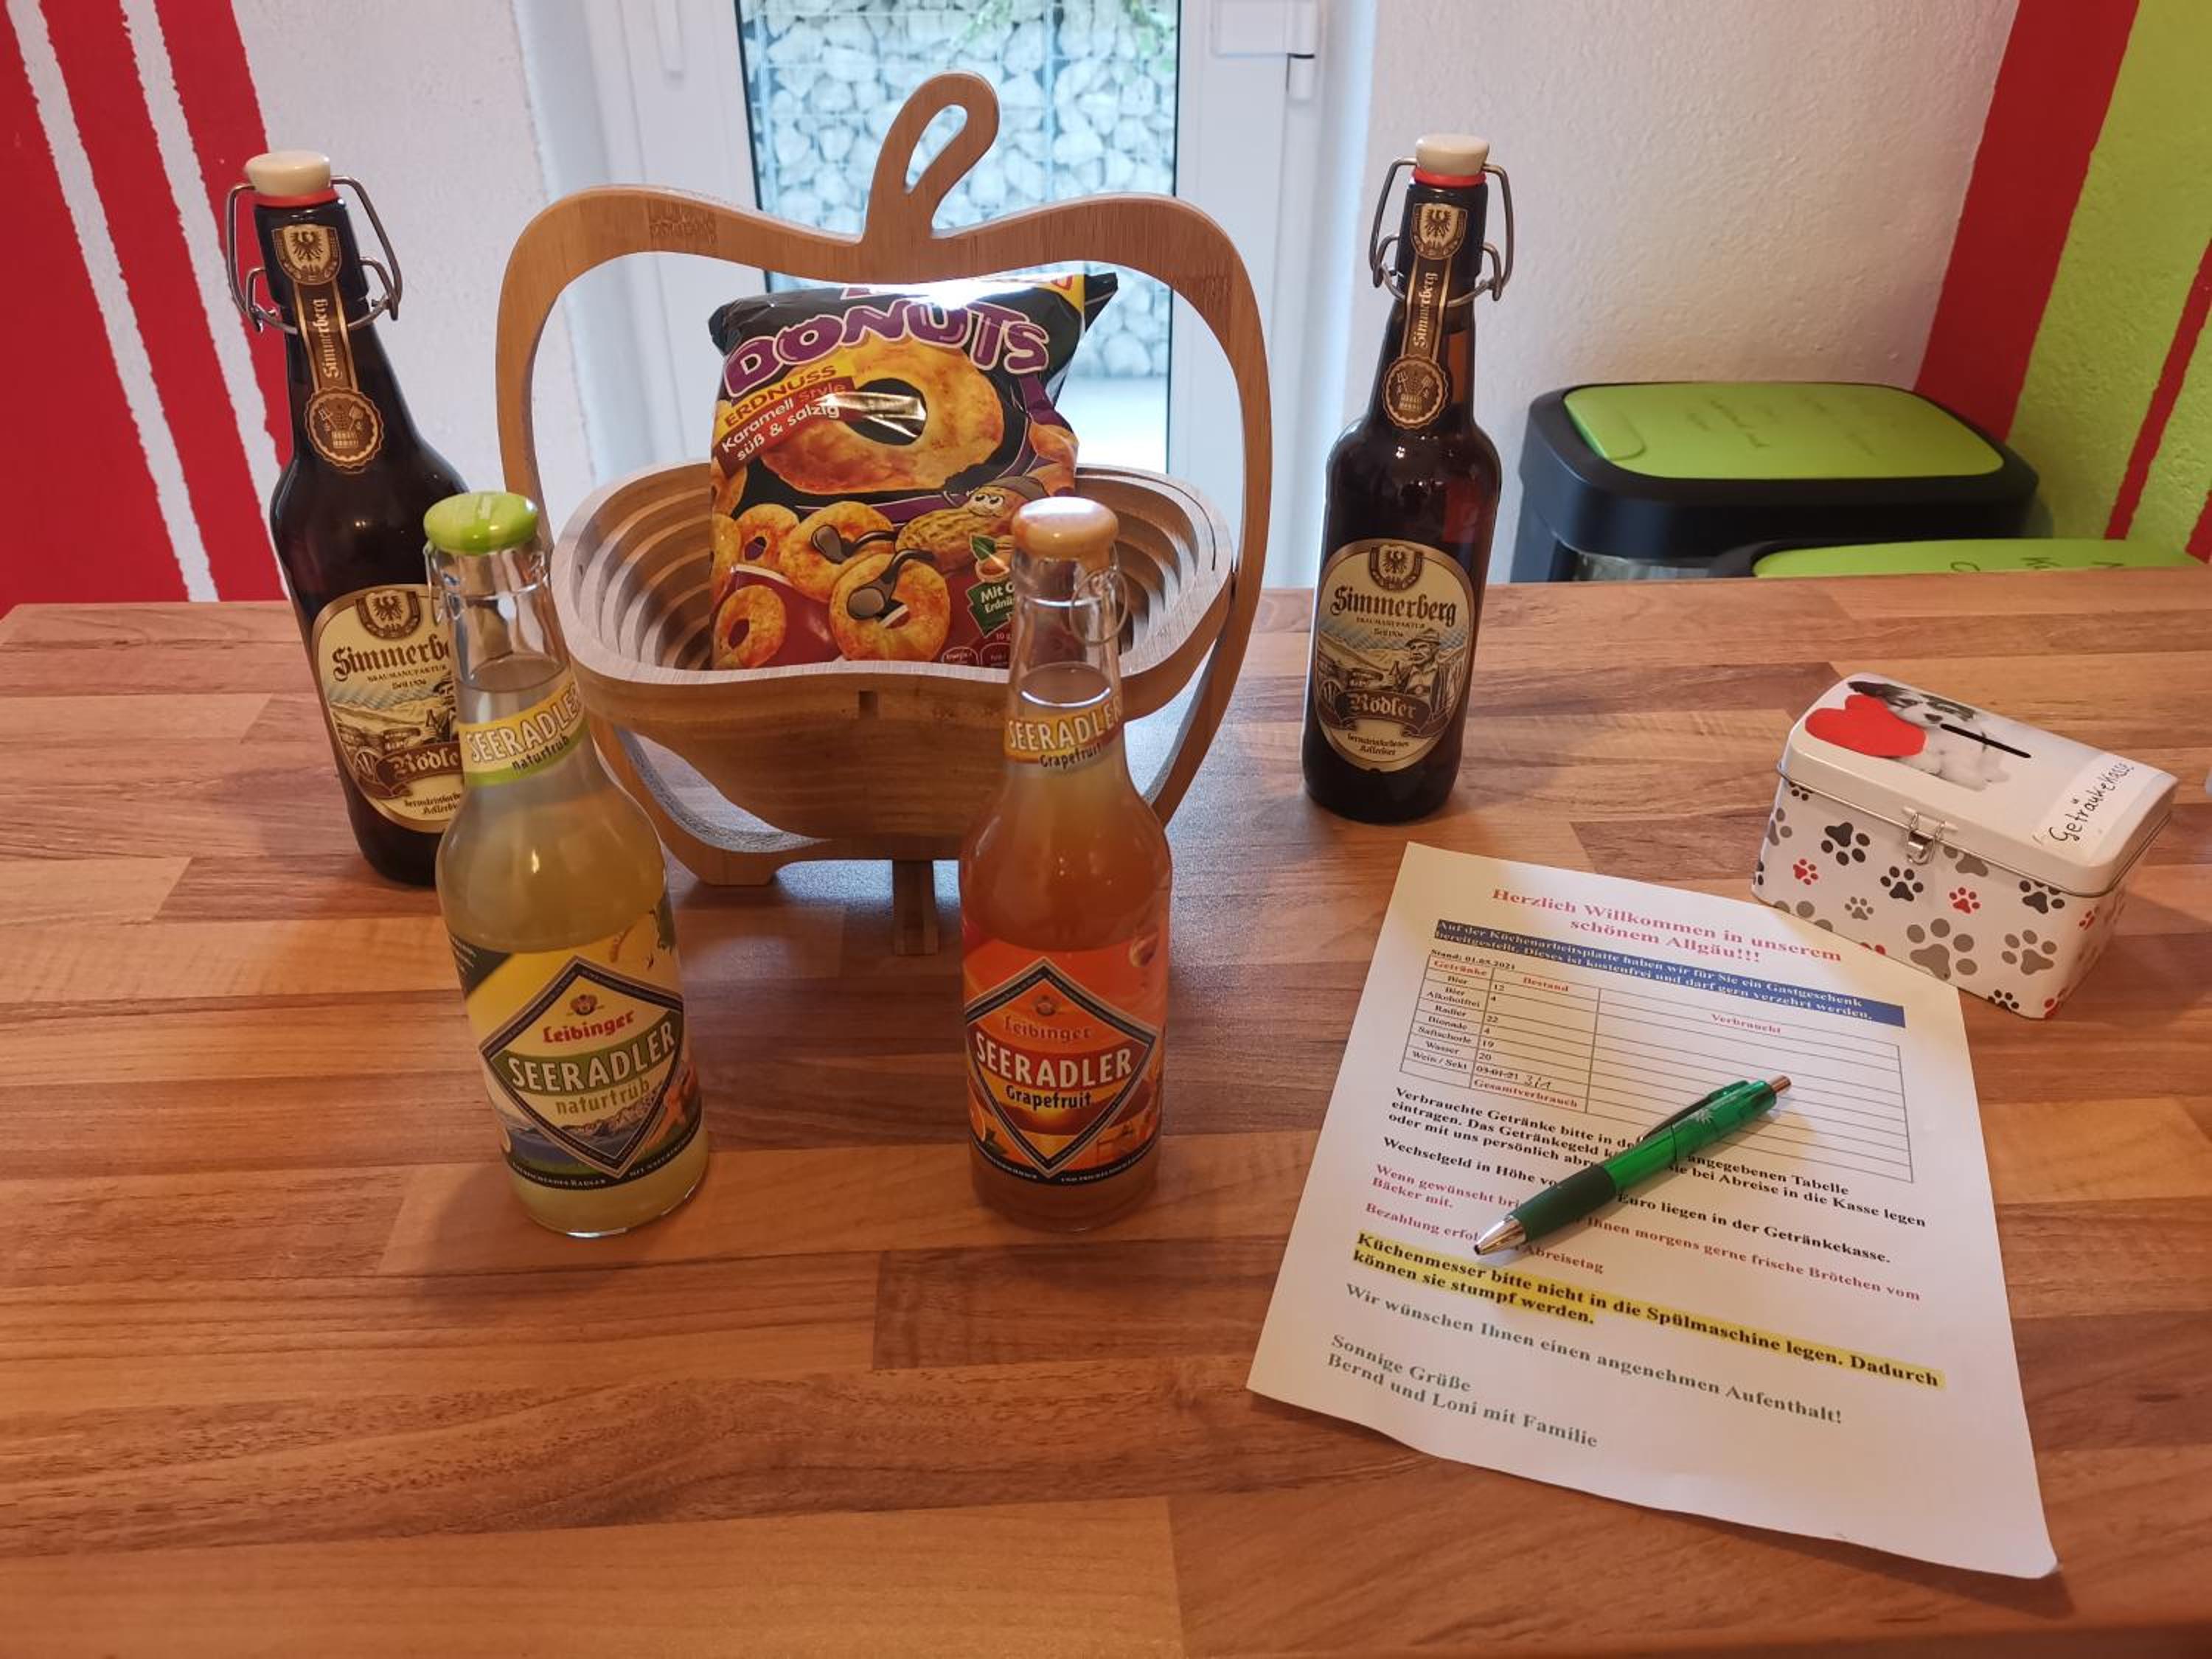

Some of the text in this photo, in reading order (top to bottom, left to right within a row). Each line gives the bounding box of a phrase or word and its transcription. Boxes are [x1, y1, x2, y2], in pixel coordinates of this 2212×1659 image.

[723, 297, 1048, 397] DONUTS
[725, 365, 837, 428] ERDNUSS
[722, 397, 793, 453] Karamell
[738, 404, 839, 460] süß & salzig
[981, 586, 1003, 603] Mit
[985, 598, 1015, 613] Erdnü
[1330, 585, 1457, 627] Simmerberg
[333, 633, 449, 682] Simmerb
[1008, 696, 1121, 751] SEERADLER
[1349, 693, 1416, 720] Rödler
[388, 747, 459, 779] Rödle
[1040, 743, 1101, 769] Grapefruit
[1492, 888, 1841, 961] Herzlich Willkommen in unserem
[1571, 920, 1760, 962] schönem Allgäu!!!
[1430, 948, 1462, 961] Stand:
[1439, 922, 1863, 1008] Auf der Küchenarbeitsplatte haben wir für Sie ein Gastgeschenk
[1427, 990, 1481, 1008] Alkoholfrei
[1434, 960, 1781, 1034] Getränke Bestand Verbraucht
[1445, 987, 1465, 996] Bier
[1448, 975, 1505, 992] Bier 12
[1568, 956, 1581, 965] ist
[1655, 973, 1681, 985] und
[1686, 978, 1714, 992] darf
[1719, 984, 1748, 998] gern
[1753, 992, 1812, 1009] verzehrt
[1816, 1004, 1872, 1020] werden.
[543, 1010, 634, 1043] Leibinger
[1004, 1015, 1091, 1043] Leibinger
[1418, 1026, 1495, 1048] Saftschorle 19
[1428, 1016, 1468, 1030] Bionade
[1435, 1005, 1499, 1023] Radler 22
[508, 1022, 675, 1091] SEERADLER
[976, 1032, 1132, 1088] SEERADLER
[1412, 1050, 1436, 1063] Wein
[1444, 1060, 1467, 1070] Sekt
[1425, 1040, 1492, 1061] Wasser 20
[556, 1079, 650, 1115] naturtrüb
[1006, 1085, 1093, 1110] Grapefruit
[1474, 1078, 1577, 1108] Gesamtverbrauch
[1388, 1113, 1422, 1130] oder
[1425, 1122, 1450, 1138] mit
[1453, 1130, 1478, 1143] uns
[1484, 1137, 1559, 1161] persönlich
[1396, 1087, 1848, 1195] Verbrauchte Getränke bitte in de angegebenen Tabelle
[1391, 1102, 1464, 1126] eintragen.
[1468, 1119, 1488, 1133] Das
[1499, 1127, 1598, 1156] Getränkegeld
[1692, 1166, 1715, 1180] bei
[1718, 1175, 1778, 1194] Abreise
[1784, 1187, 1798, 1199] in
[1804, 1192, 1827, 1205] die
[1832, 1197, 1879, 1217] Kasse
[1885, 1208, 1926, 1227] legen
[1372, 1178, 1453, 1208] Bäcker mit.
[1383, 1136, 1891, 1263] Wechselgeld in Höhe vo Euro liegen in der Getränkekasse.
[1366, 1203, 1604, 1274] Bezahlung erfol Abreisetag
[1376, 1164, 1415, 1185] Wenn
[1419, 1179, 1494, 1206] gewünscht
[1587, 1217, 1630, 1234] Ihnen
[1635, 1229, 1700, 1250] morgens
[1704, 1245, 1747, 1262] gerne
[1752, 1254, 1804, 1275] frische
[1809, 1267, 1881, 1293] Brötchen
[1887, 1287, 1920, 1301] vom
[1353, 1250, 1595, 1325] können sie stumpf werden.
[1356, 1233, 1938, 1387] Küchenmesser bitte nicht in die Spülmaschine legen. Dadurch
[1332, 1334, 1472, 1392] Sonnige Grüße
[1346, 1282, 1842, 1424] Wir wünschen Ihnen einen angenehmen Aufenthalt!
[1329, 1354, 1597, 1448] Bernd und Loni mit Familie
